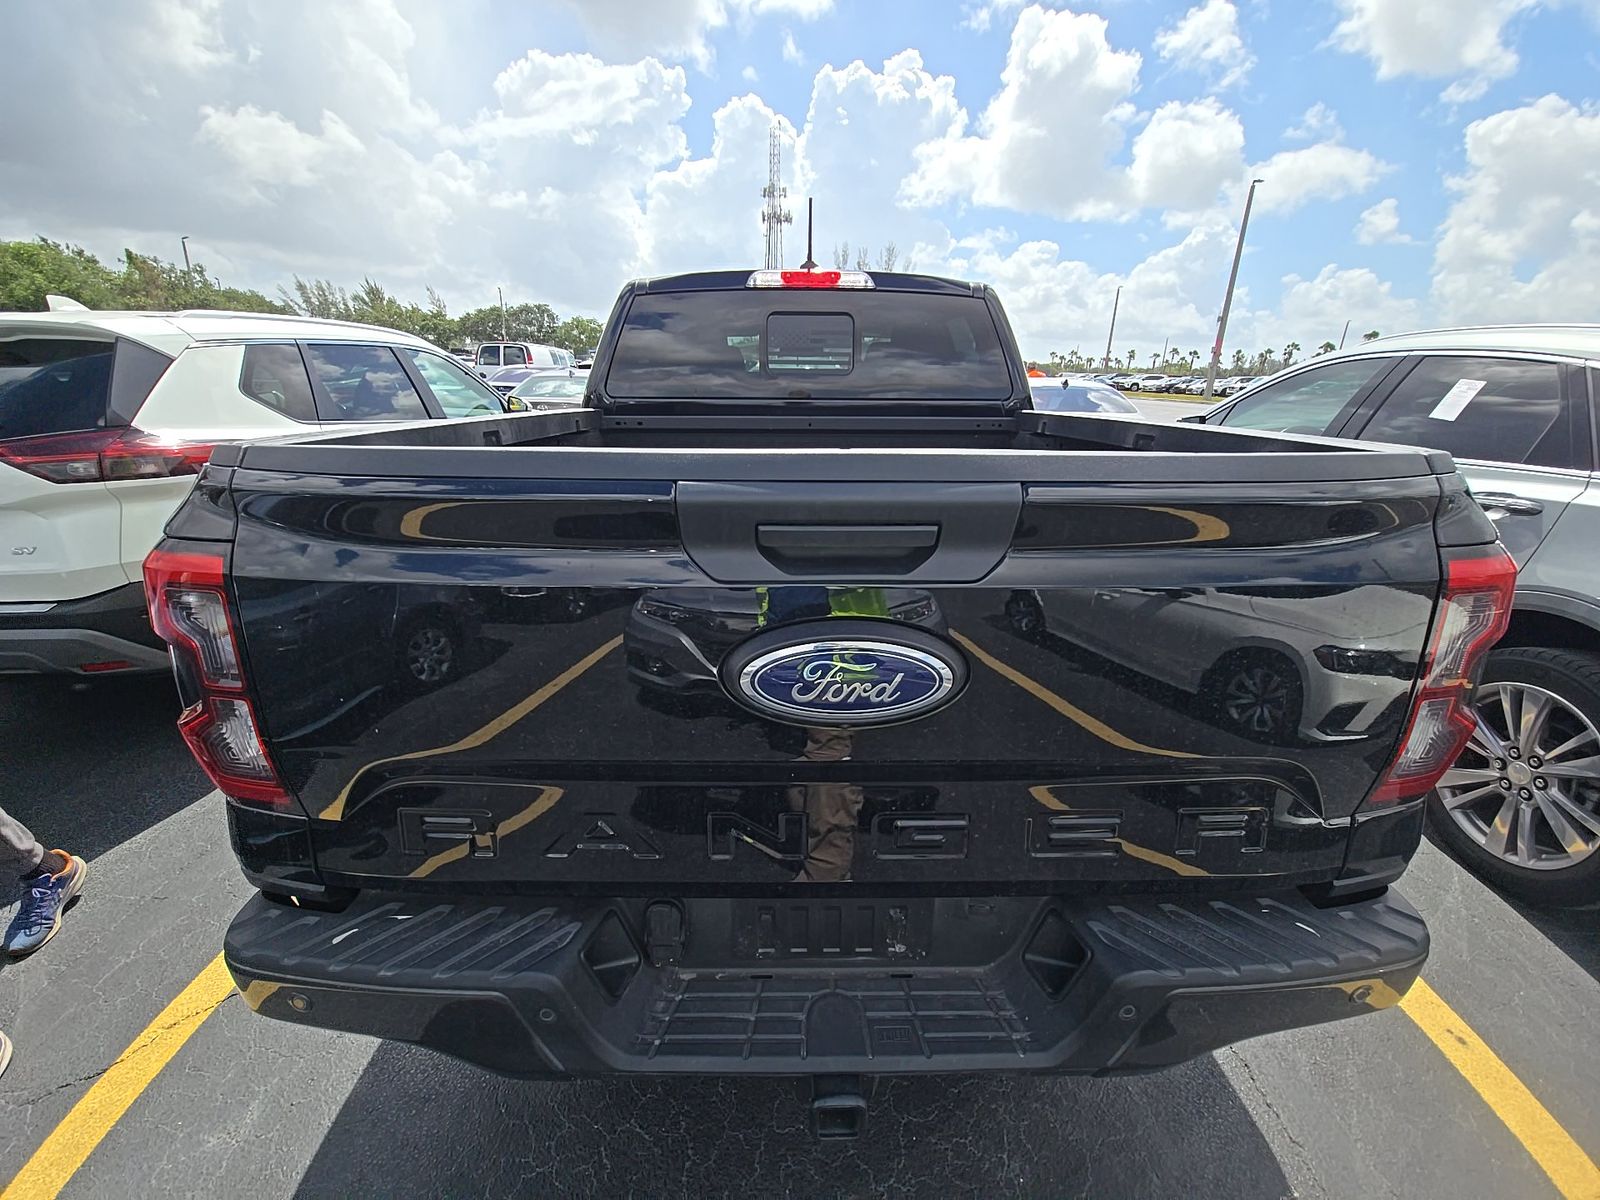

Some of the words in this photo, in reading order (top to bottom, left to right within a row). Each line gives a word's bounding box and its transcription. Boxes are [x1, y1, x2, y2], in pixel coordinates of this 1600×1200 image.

[11, 546, 38, 556] SV
[791, 660, 905, 703] Ford
[397, 807, 1270, 860] RANGER
